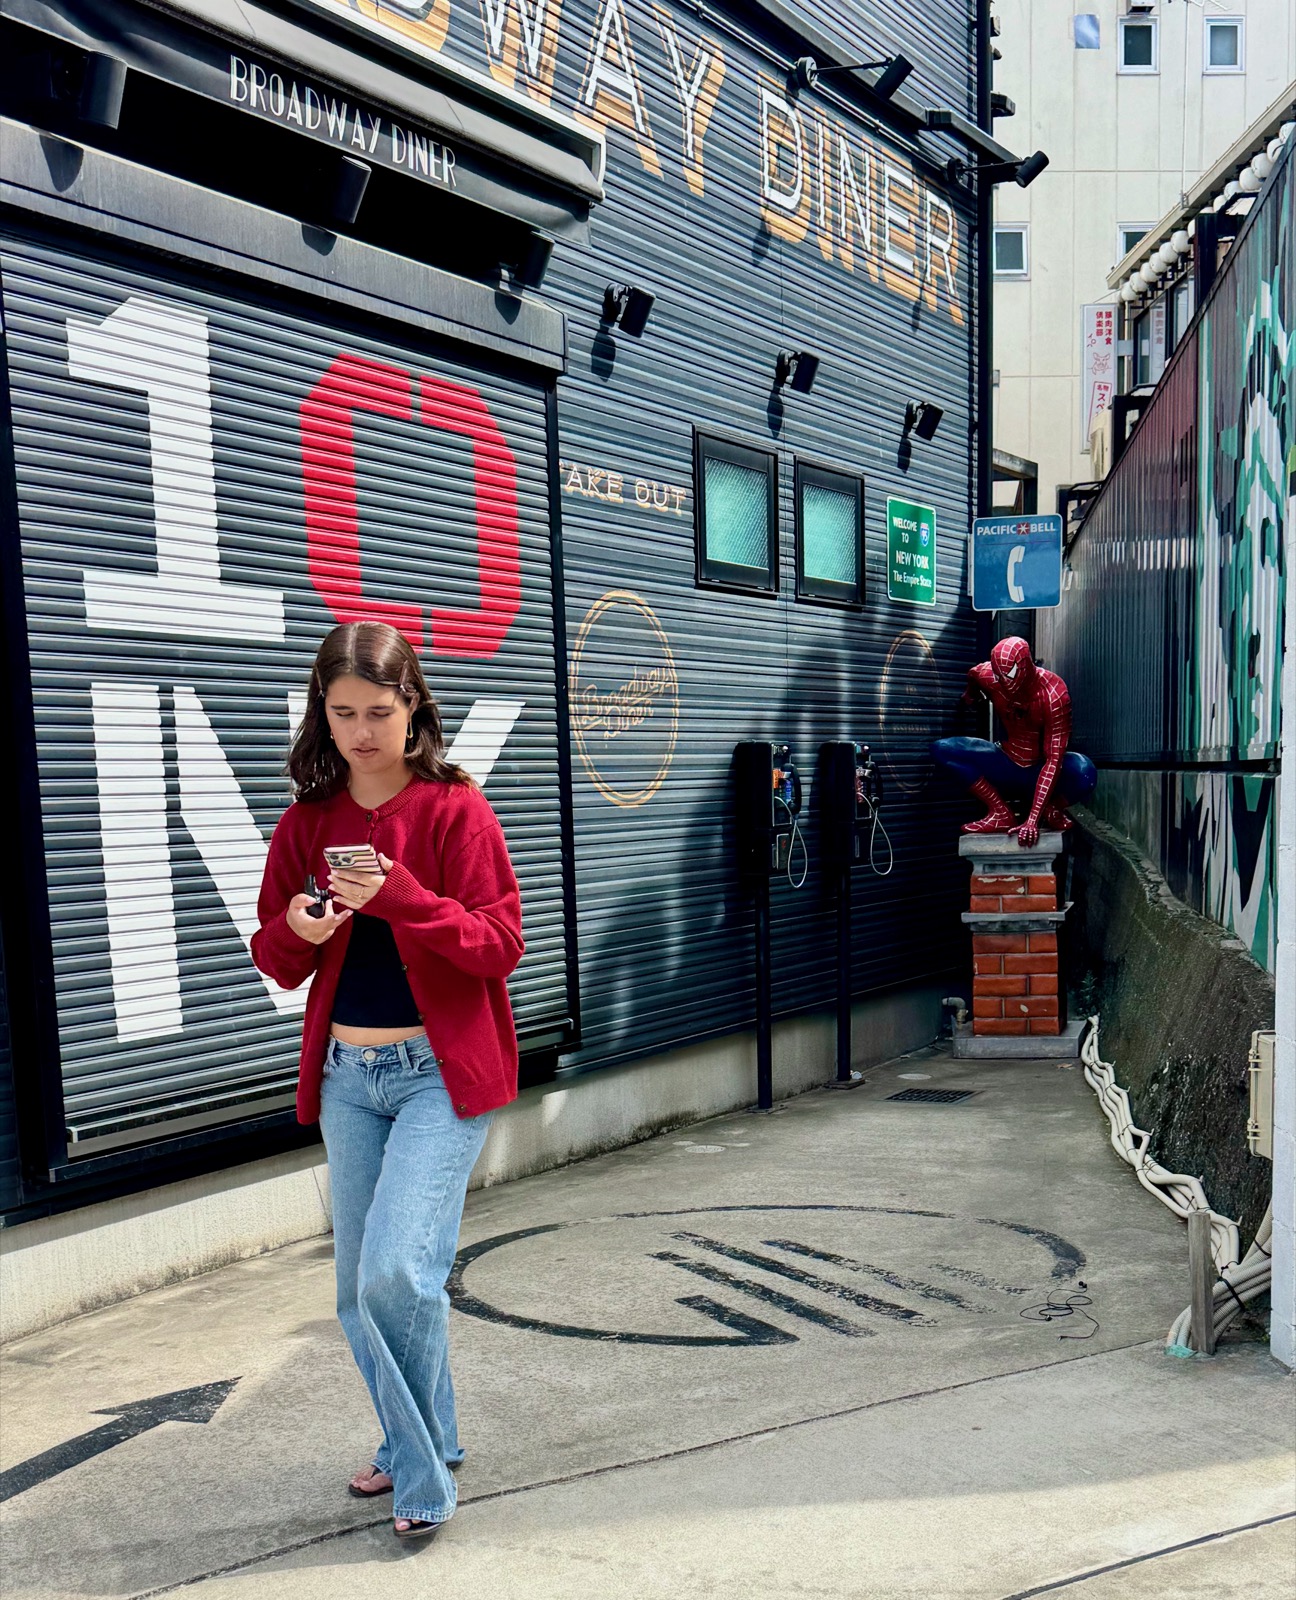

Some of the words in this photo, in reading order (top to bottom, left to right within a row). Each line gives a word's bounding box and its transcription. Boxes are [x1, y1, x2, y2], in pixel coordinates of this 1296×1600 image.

[229, 54, 382, 154] BROADWAY
[391, 123, 457, 187] DINER
[758, 75, 963, 322] DINER
[559, 461, 624, 503] AKE
[634, 478, 687, 516] OUT
[892, 516, 918, 532] WELCOME
[976, 524, 1017, 536] PACIFIC
[1030, 522, 1056, 533] BELL
[901, 532, 910, 544] TO
[895, 550, 912, 566] NEW
[912, 553, 930, 570] YORK
[892, 570, 903, 582] The
[903, 572, 920, 587] Empire
[919, 575, 932, 588] State
